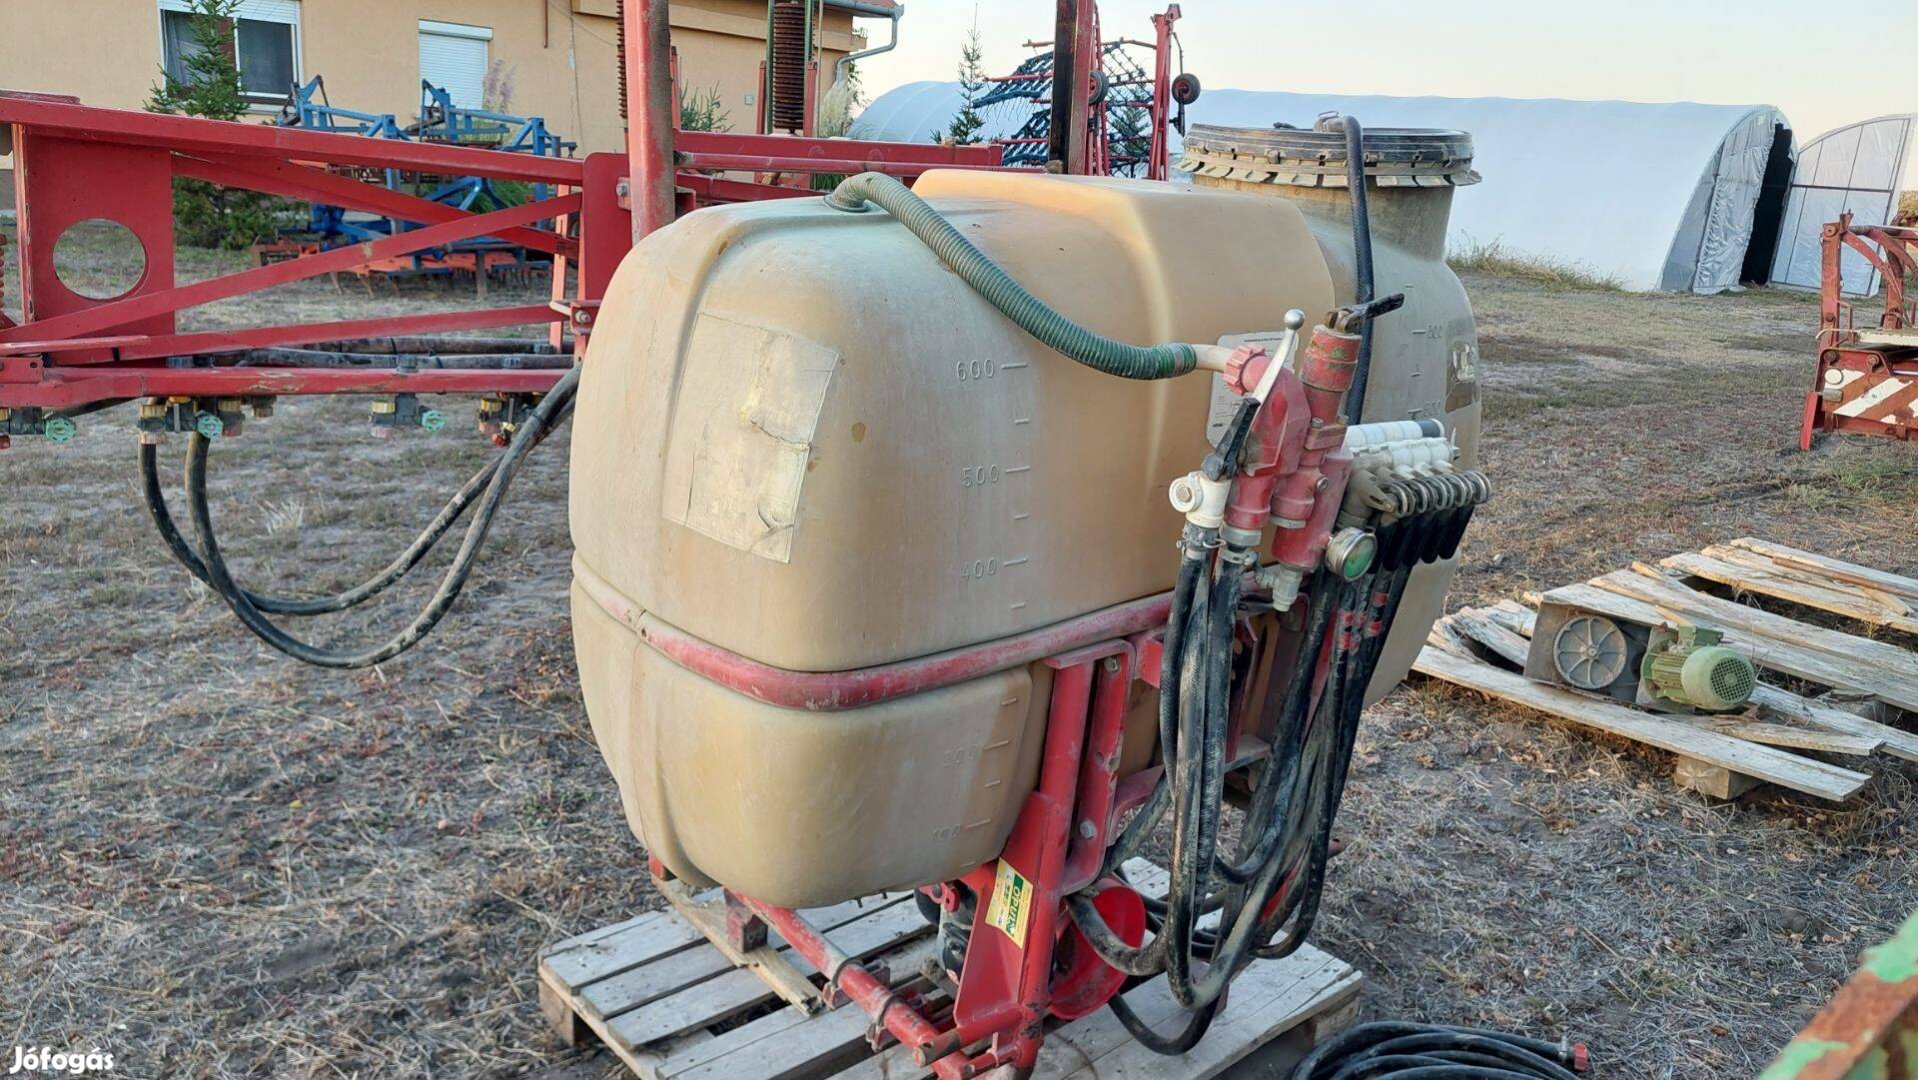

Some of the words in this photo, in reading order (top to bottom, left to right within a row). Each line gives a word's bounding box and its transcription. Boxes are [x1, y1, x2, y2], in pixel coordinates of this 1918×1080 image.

[956, 358, 995, 382] 600
[961, 463, 1000, 488] 500
[960, 556, 998, 582] 400
